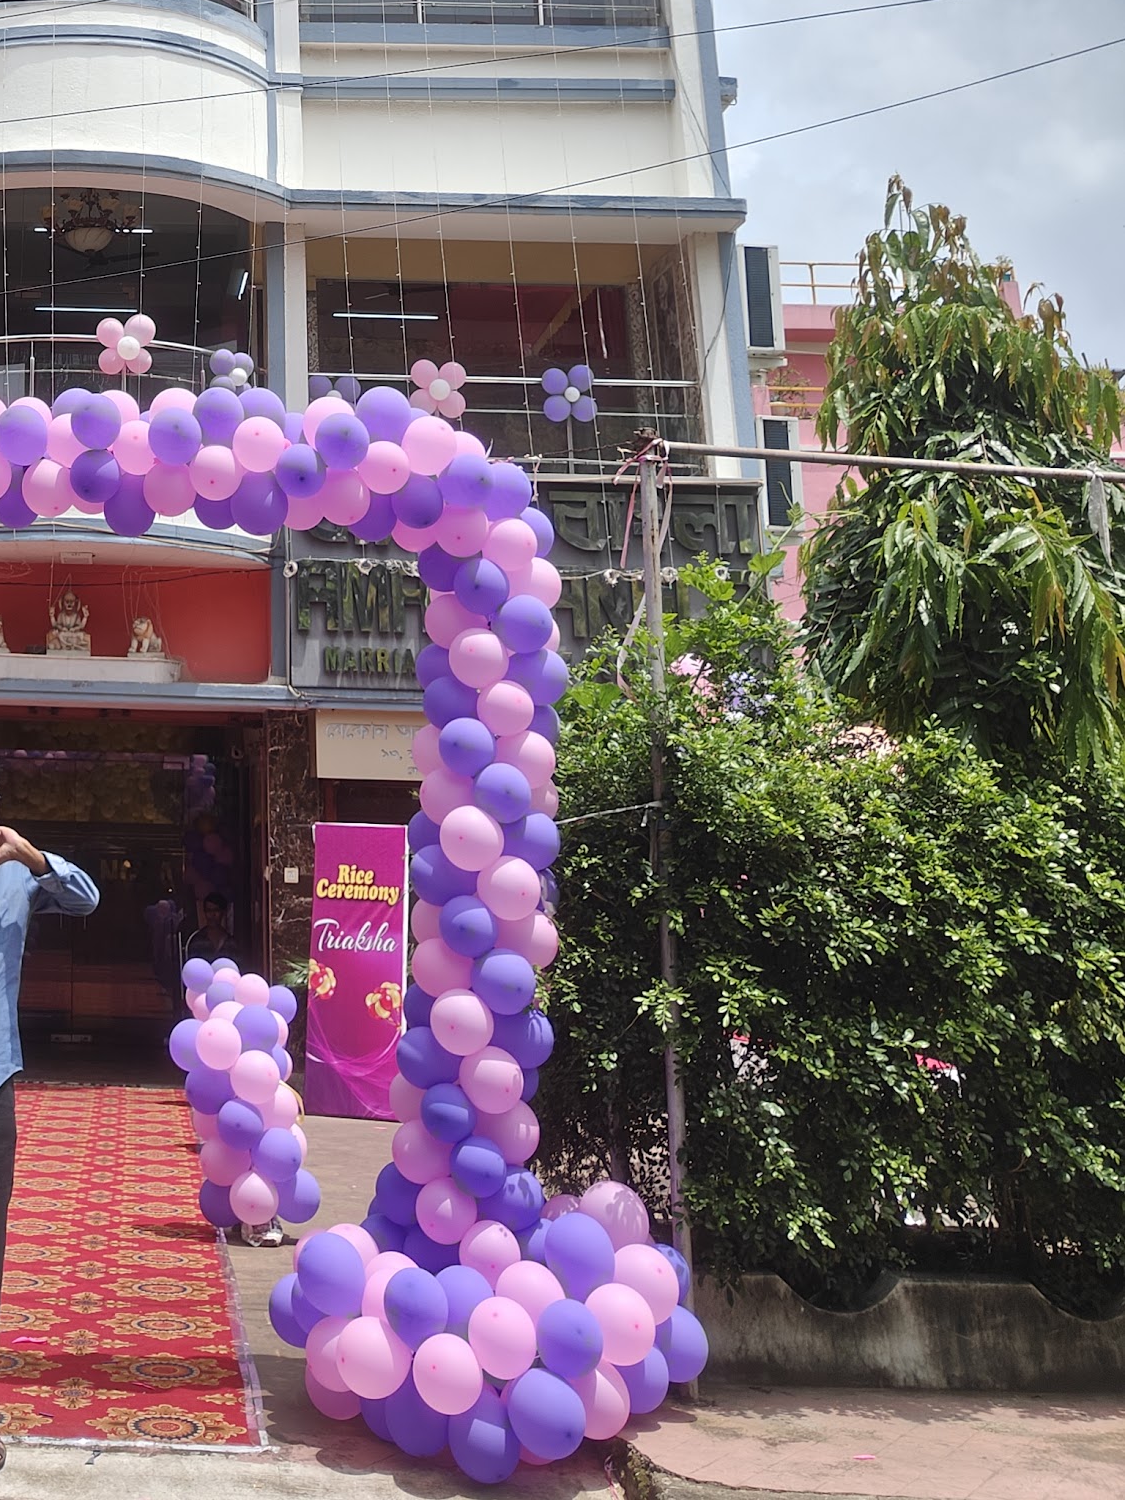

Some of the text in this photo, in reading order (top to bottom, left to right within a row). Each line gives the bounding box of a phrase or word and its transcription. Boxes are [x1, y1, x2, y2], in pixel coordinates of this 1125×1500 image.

[298, 560, 430, 633] AMA
[324, 647, 415, 673] MARRIA
[337, 864, 374, 885] Rice
[316, 878, 399, 905] Ceremony
[313, 918, 398, 952] Triaksha
